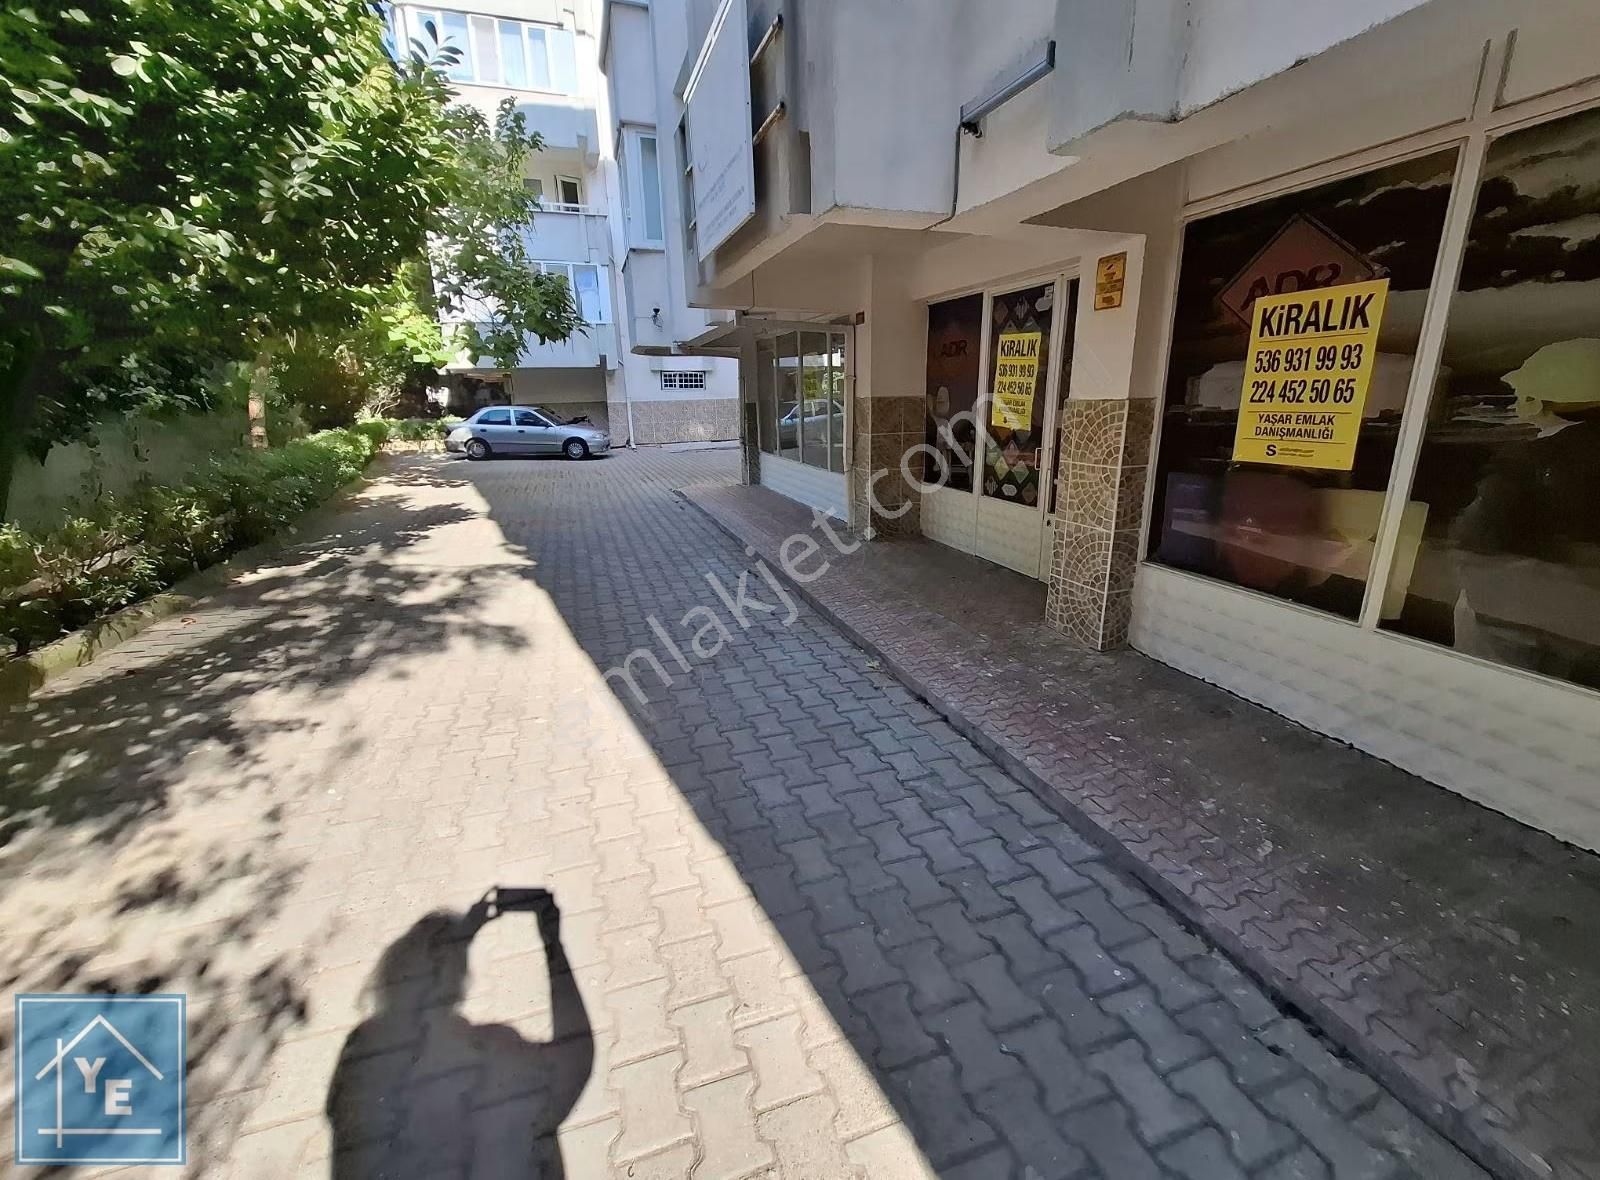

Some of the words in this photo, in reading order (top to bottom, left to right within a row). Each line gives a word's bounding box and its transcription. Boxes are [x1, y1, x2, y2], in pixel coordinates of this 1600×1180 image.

[1254, 350, 1280, 373] 536
[1284, 347, 1312, 372] 931
[1315, 345, 1337, 371] 99
[1340, 343, 1363, 370] 93
[1250, 380, 1276, 404] 224
[1278, 379, 1307, 404] 452
[1309, 378, 1331, 404] 50
[1333, 378, 1357, 404] 65
[1258, 413, 1292, 426] YAŞAR
[1295, 414, 1336, 426] EMLAK
[1254, 426, 1334, 440] DANIŞMANLIĞI
[1265, 444, 1277, 456] S
